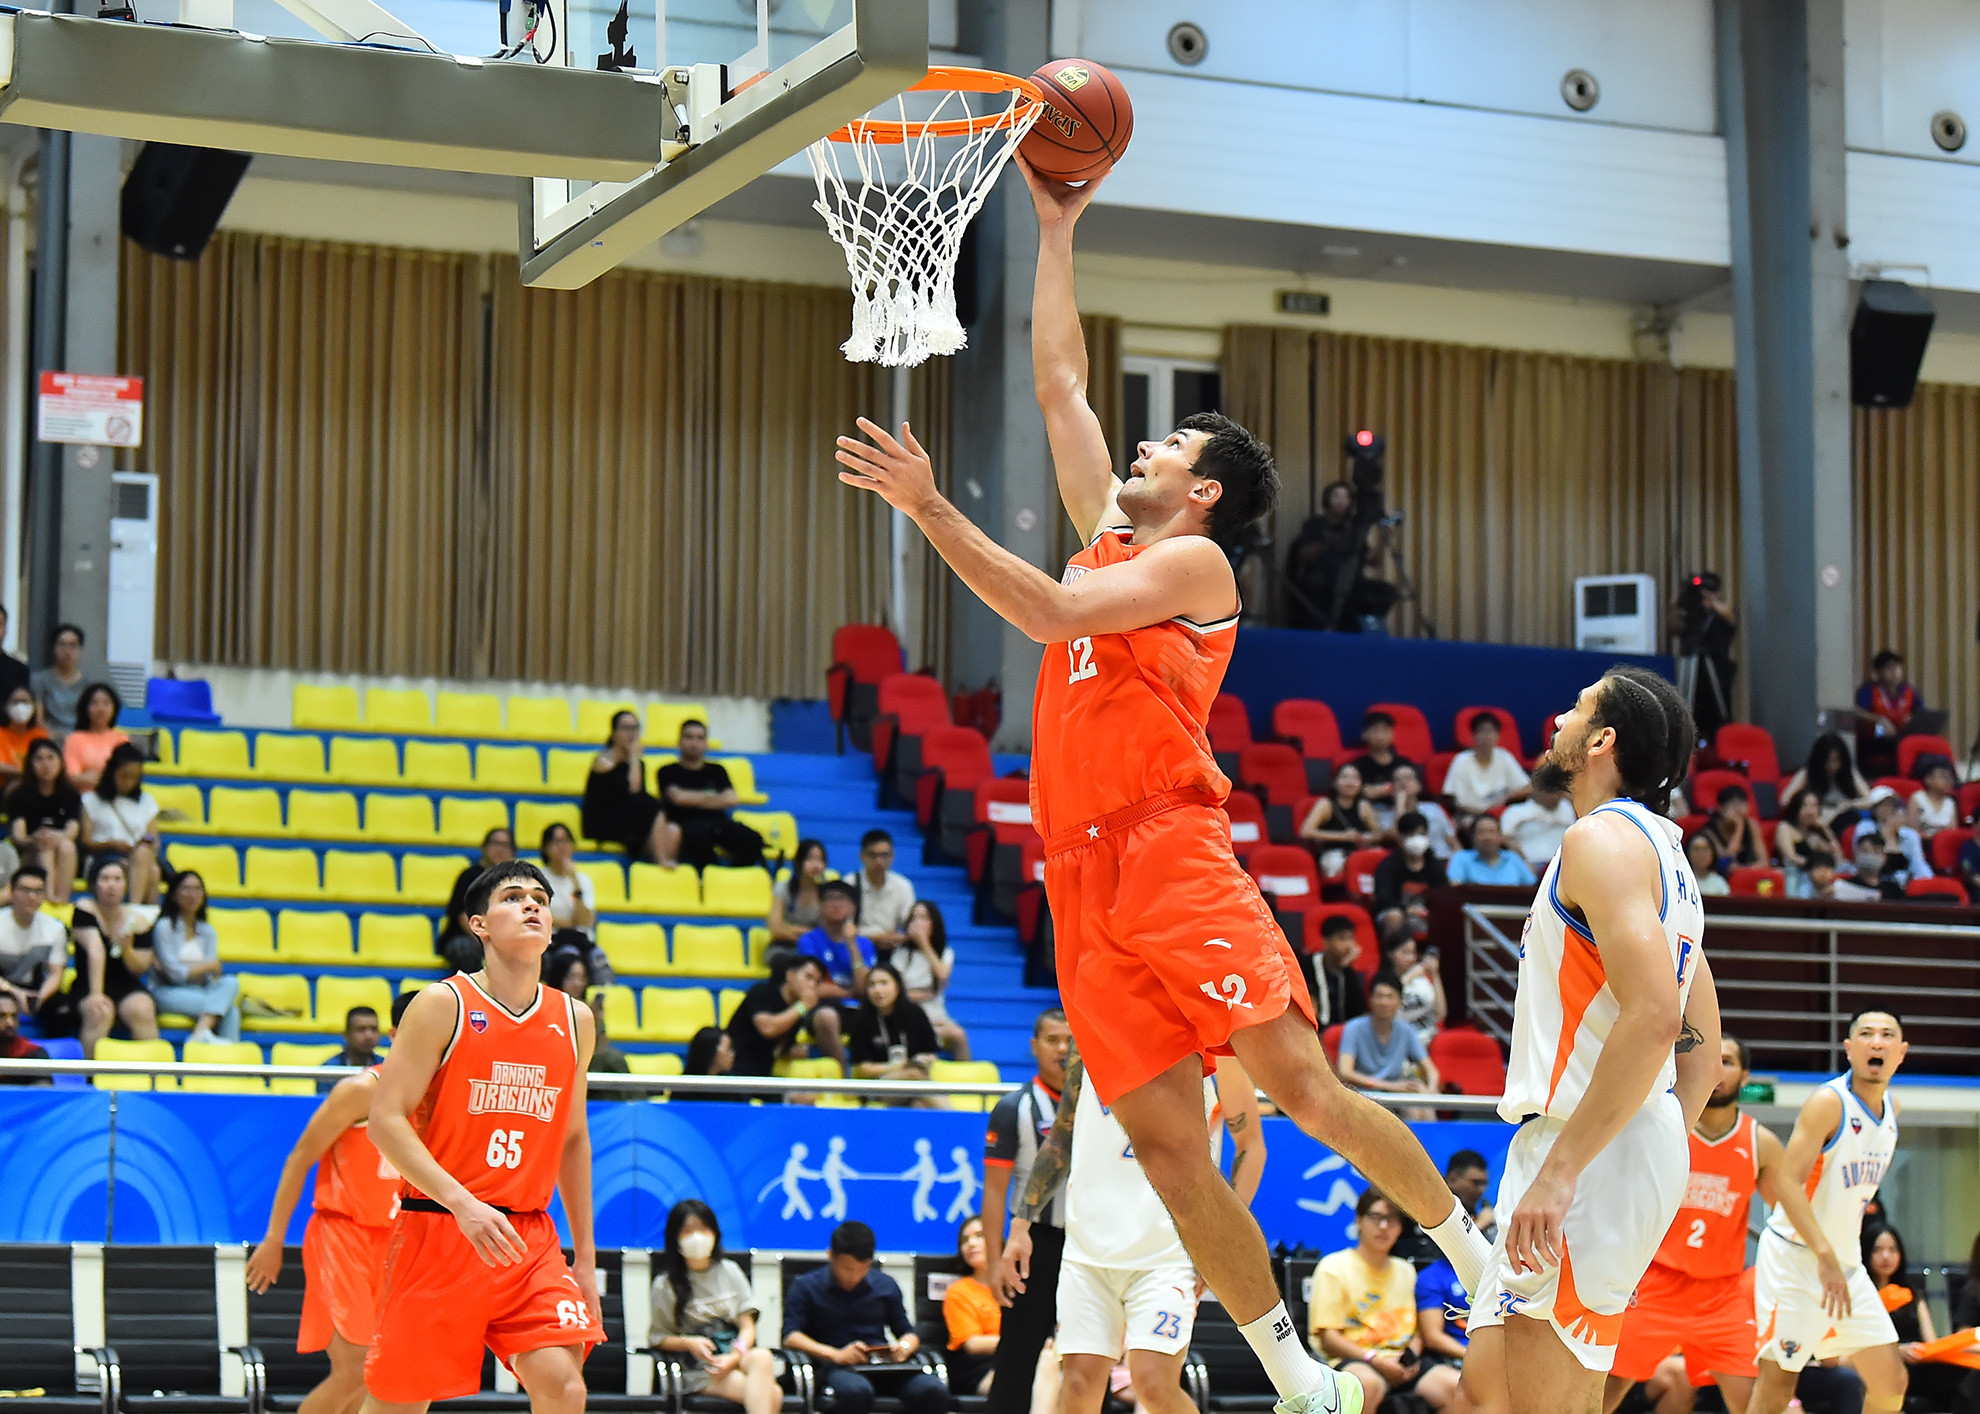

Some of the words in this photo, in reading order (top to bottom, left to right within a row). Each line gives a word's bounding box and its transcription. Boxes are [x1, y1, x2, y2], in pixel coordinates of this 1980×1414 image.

[1060, 71, 1078, 86] VBA
[1067, 635, 1099, 685] 12
[1199, 973, 1254, 1012] 12
[493, 1064, 545, 1089] DANANG
[471, 1083, 557, 1120] DRAGONS
[486, 1128, 525, 1170] 65
[1686, 1218, 1706, 1248] 2
[556, 1299, 590, 1330] 65
[1152, 1310, 1181, 1340] 23
